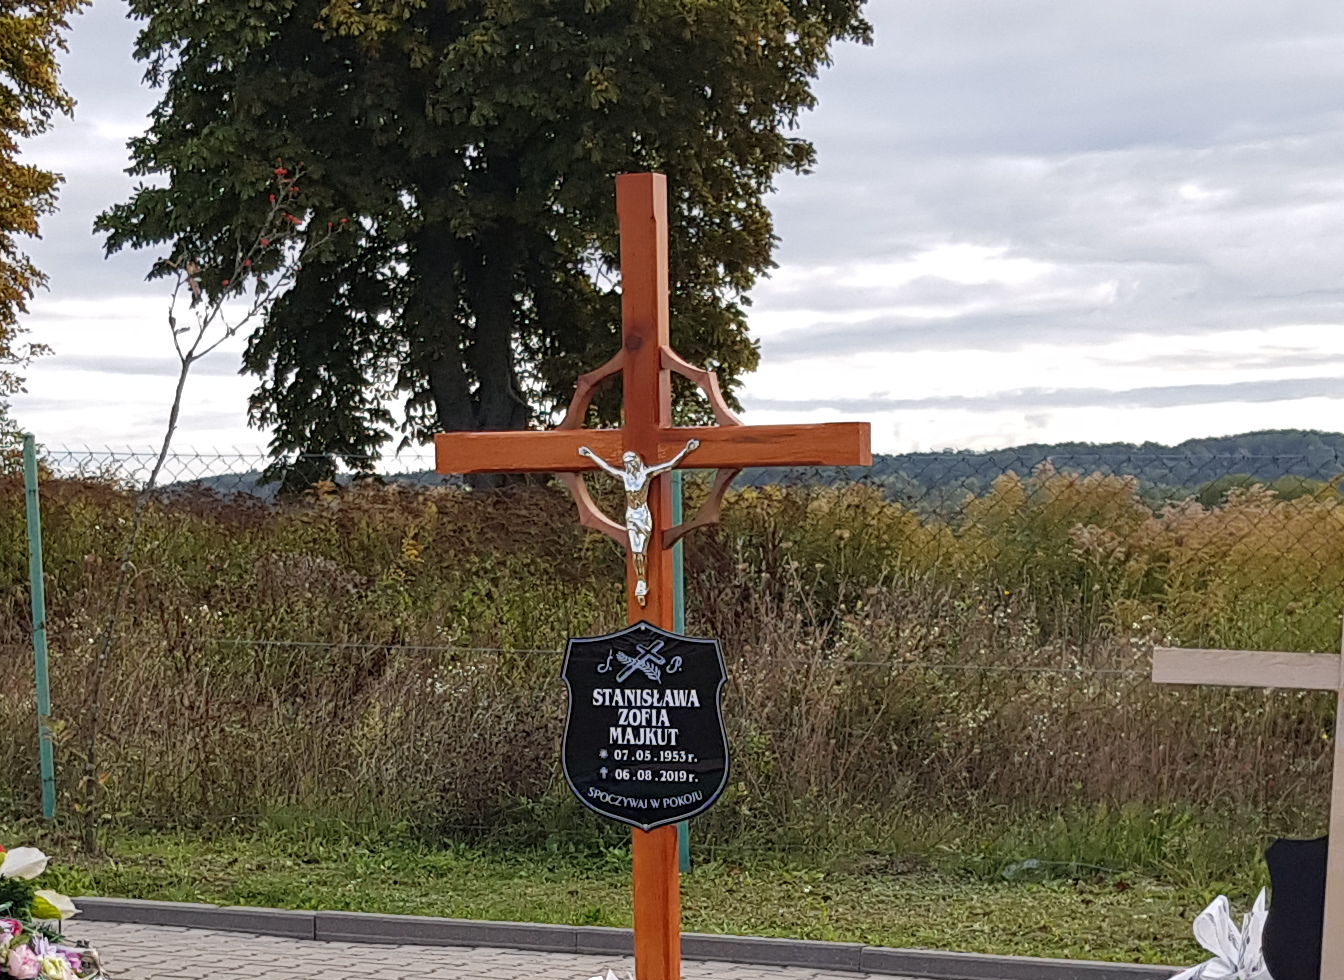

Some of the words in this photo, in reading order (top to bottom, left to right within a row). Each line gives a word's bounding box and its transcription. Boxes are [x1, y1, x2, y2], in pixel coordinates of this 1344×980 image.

[666, 656, 683, 674] P.
[592, 688, 700, 707] STANISŁAWA
[618, 708, 670, 727] ZOFIA
[609, 726, 679, 746] MAJKUT
[587, 786, 648, 809] SPOCZYWAJ
[650, 799, 660, 809] W
[663, 790, 703, 808] POKOJU
